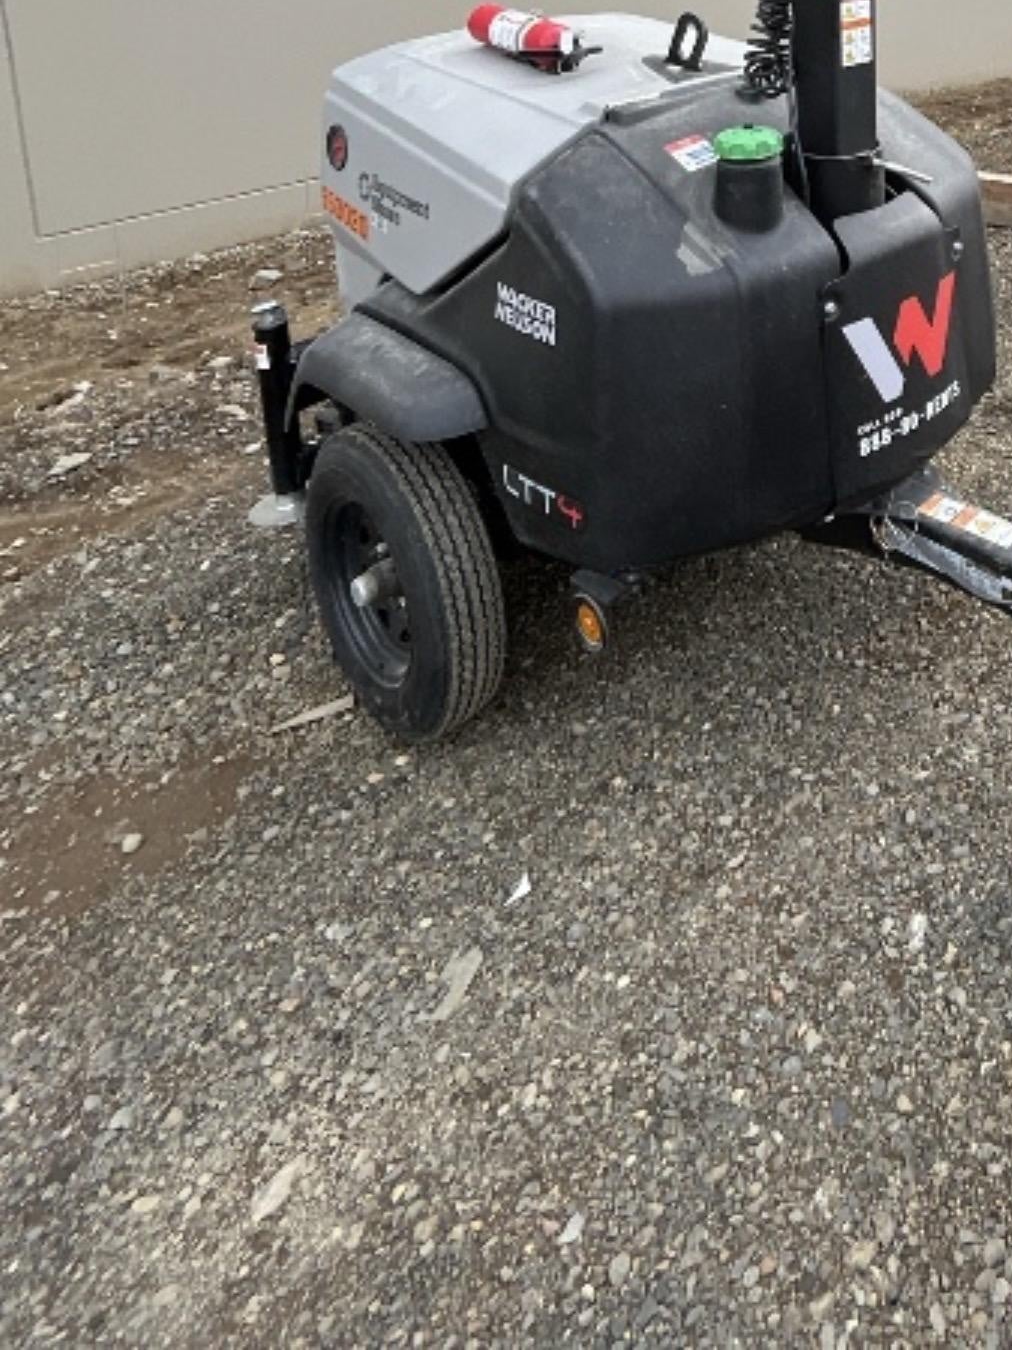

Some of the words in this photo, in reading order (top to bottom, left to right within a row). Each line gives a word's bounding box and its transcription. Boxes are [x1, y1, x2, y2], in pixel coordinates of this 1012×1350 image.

[494, 302, 556, 346] NEUSON
[496, 281, 556, 325] WACKER
[502, 463, 584, 529] LTT4
